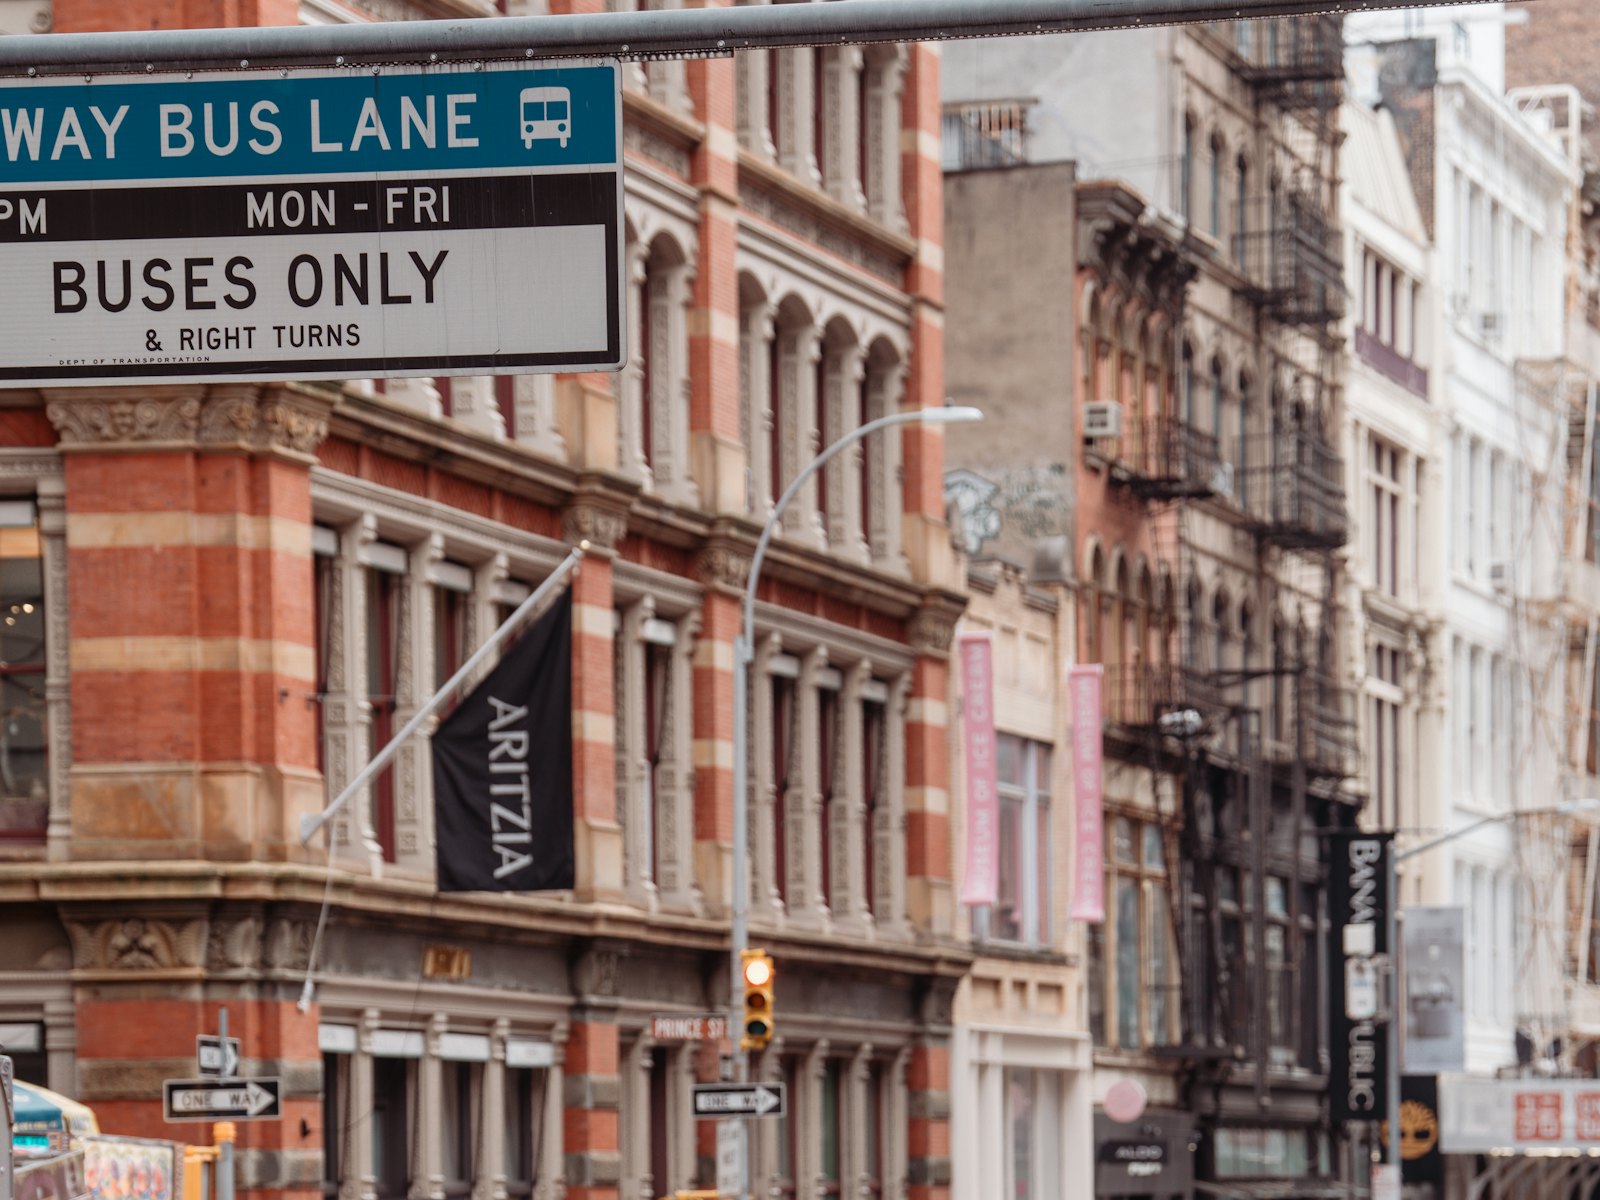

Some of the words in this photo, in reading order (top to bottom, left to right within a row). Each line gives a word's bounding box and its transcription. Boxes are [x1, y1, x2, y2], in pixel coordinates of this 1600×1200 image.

[0, 104, 131, 162] WAY
[160, 99, 284, 158] BUS
[310, 92, 480, 152] LANE
[246, 190, 336, 229] MON
[386, 186, 451, 225] FRI
[53, 256, 258, 314] BUSES
[287, 250, 450, 307] ONLY
[145, 329, 163, 351] &
[179, 326, 257, 351] RIGHT
[273, 323, 361, 347] TURNS
[112, 356, 211, 364] TRANSPORTATION
[487, 695, 533, 879] ARITZIA
[654, 1017, 702, 1039] PRINCE
[182, 1091, 214, 1110] ONE
[228, 1092, 262, 1110] WAY
